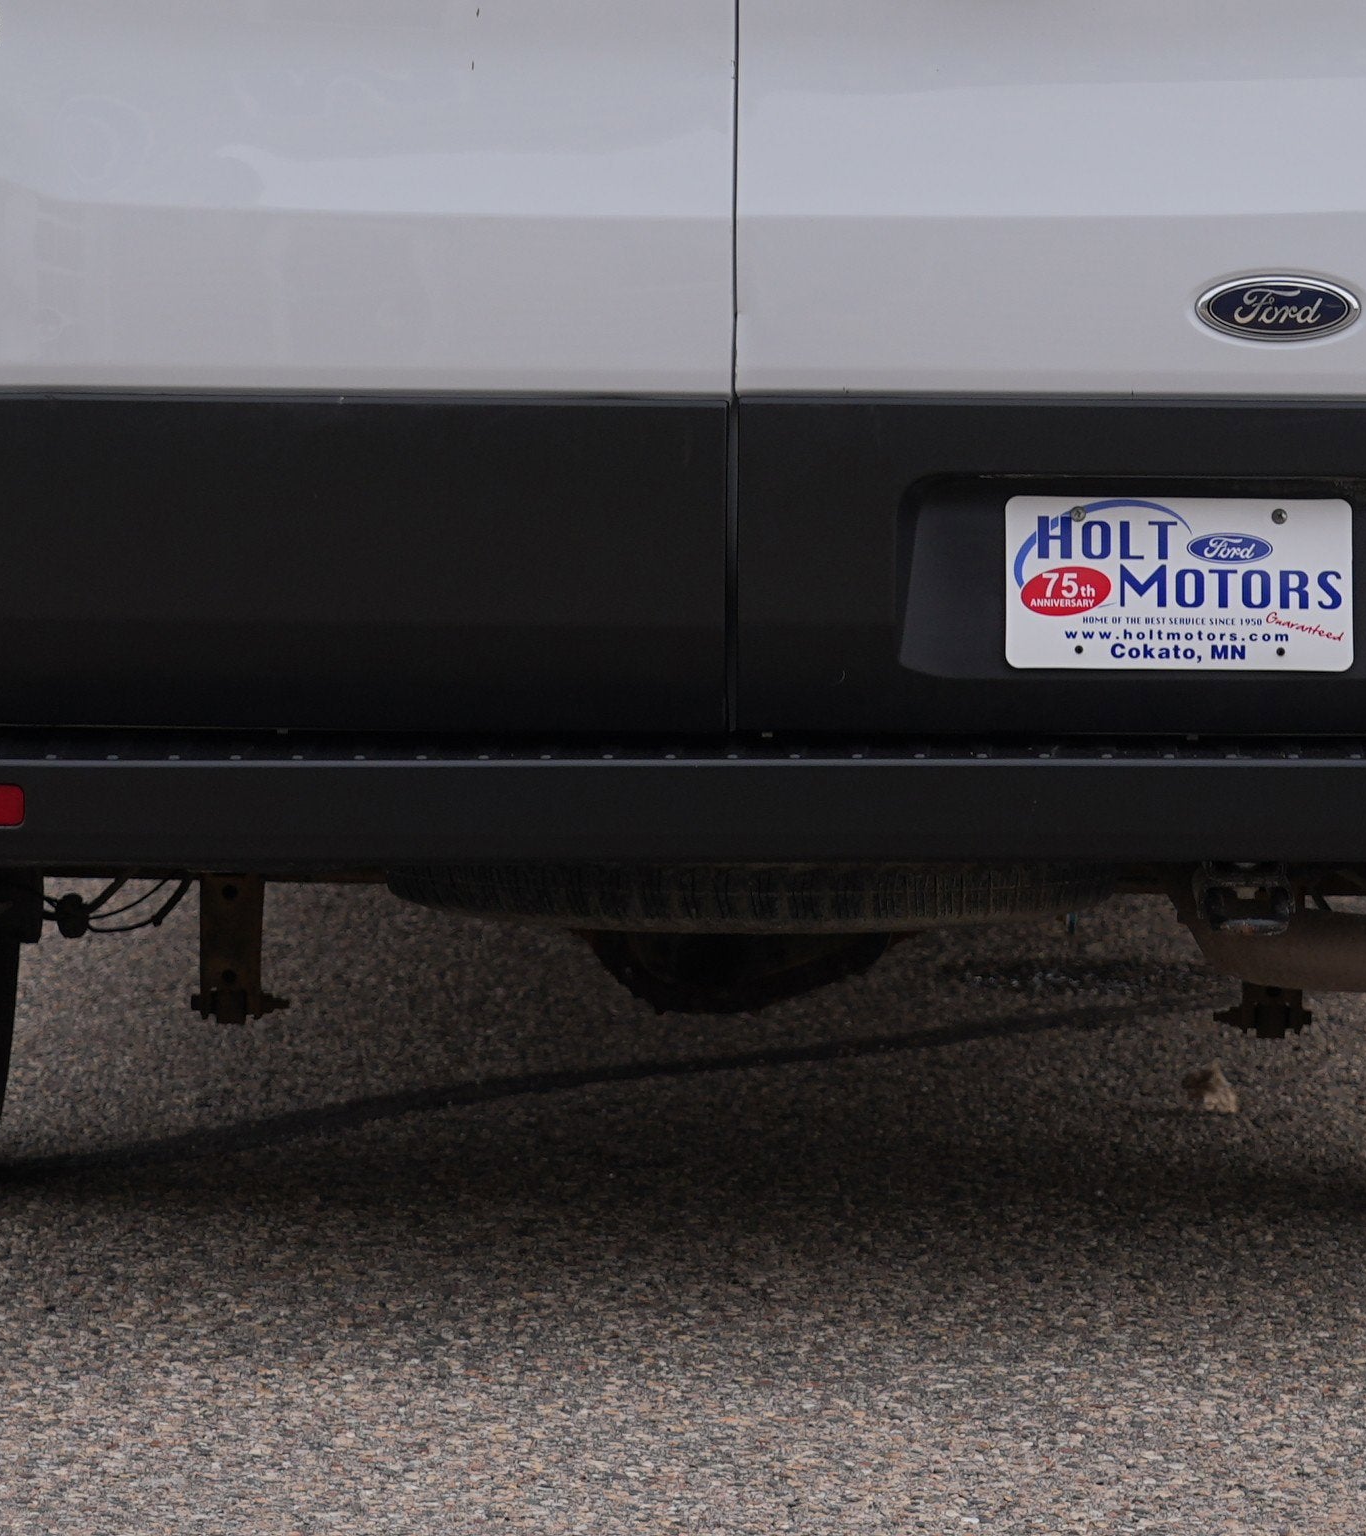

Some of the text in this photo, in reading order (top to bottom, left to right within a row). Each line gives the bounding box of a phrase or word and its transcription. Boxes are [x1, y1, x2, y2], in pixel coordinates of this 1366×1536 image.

[1233, 288, 1323, 324] Ford
[1037, 515, 1178, 560] HOLT
[1203, 536, 1256, 561] Ford
[1042, 572, 1096, 598] 75th
[1119, 564, 1343, 610] MOTORS
[1030, 597, 1095, 608] ANNIVERSARY
[1082, 616, 1263, 626] HOME OF THE BEST SERVICE SINCE 1950
[1265, 611, 1345, 642] Guaranteed
[1065, 629, 1290, 643] www.holtmotors.com
[1110, 643, 1247, 663] Cokato, MN
